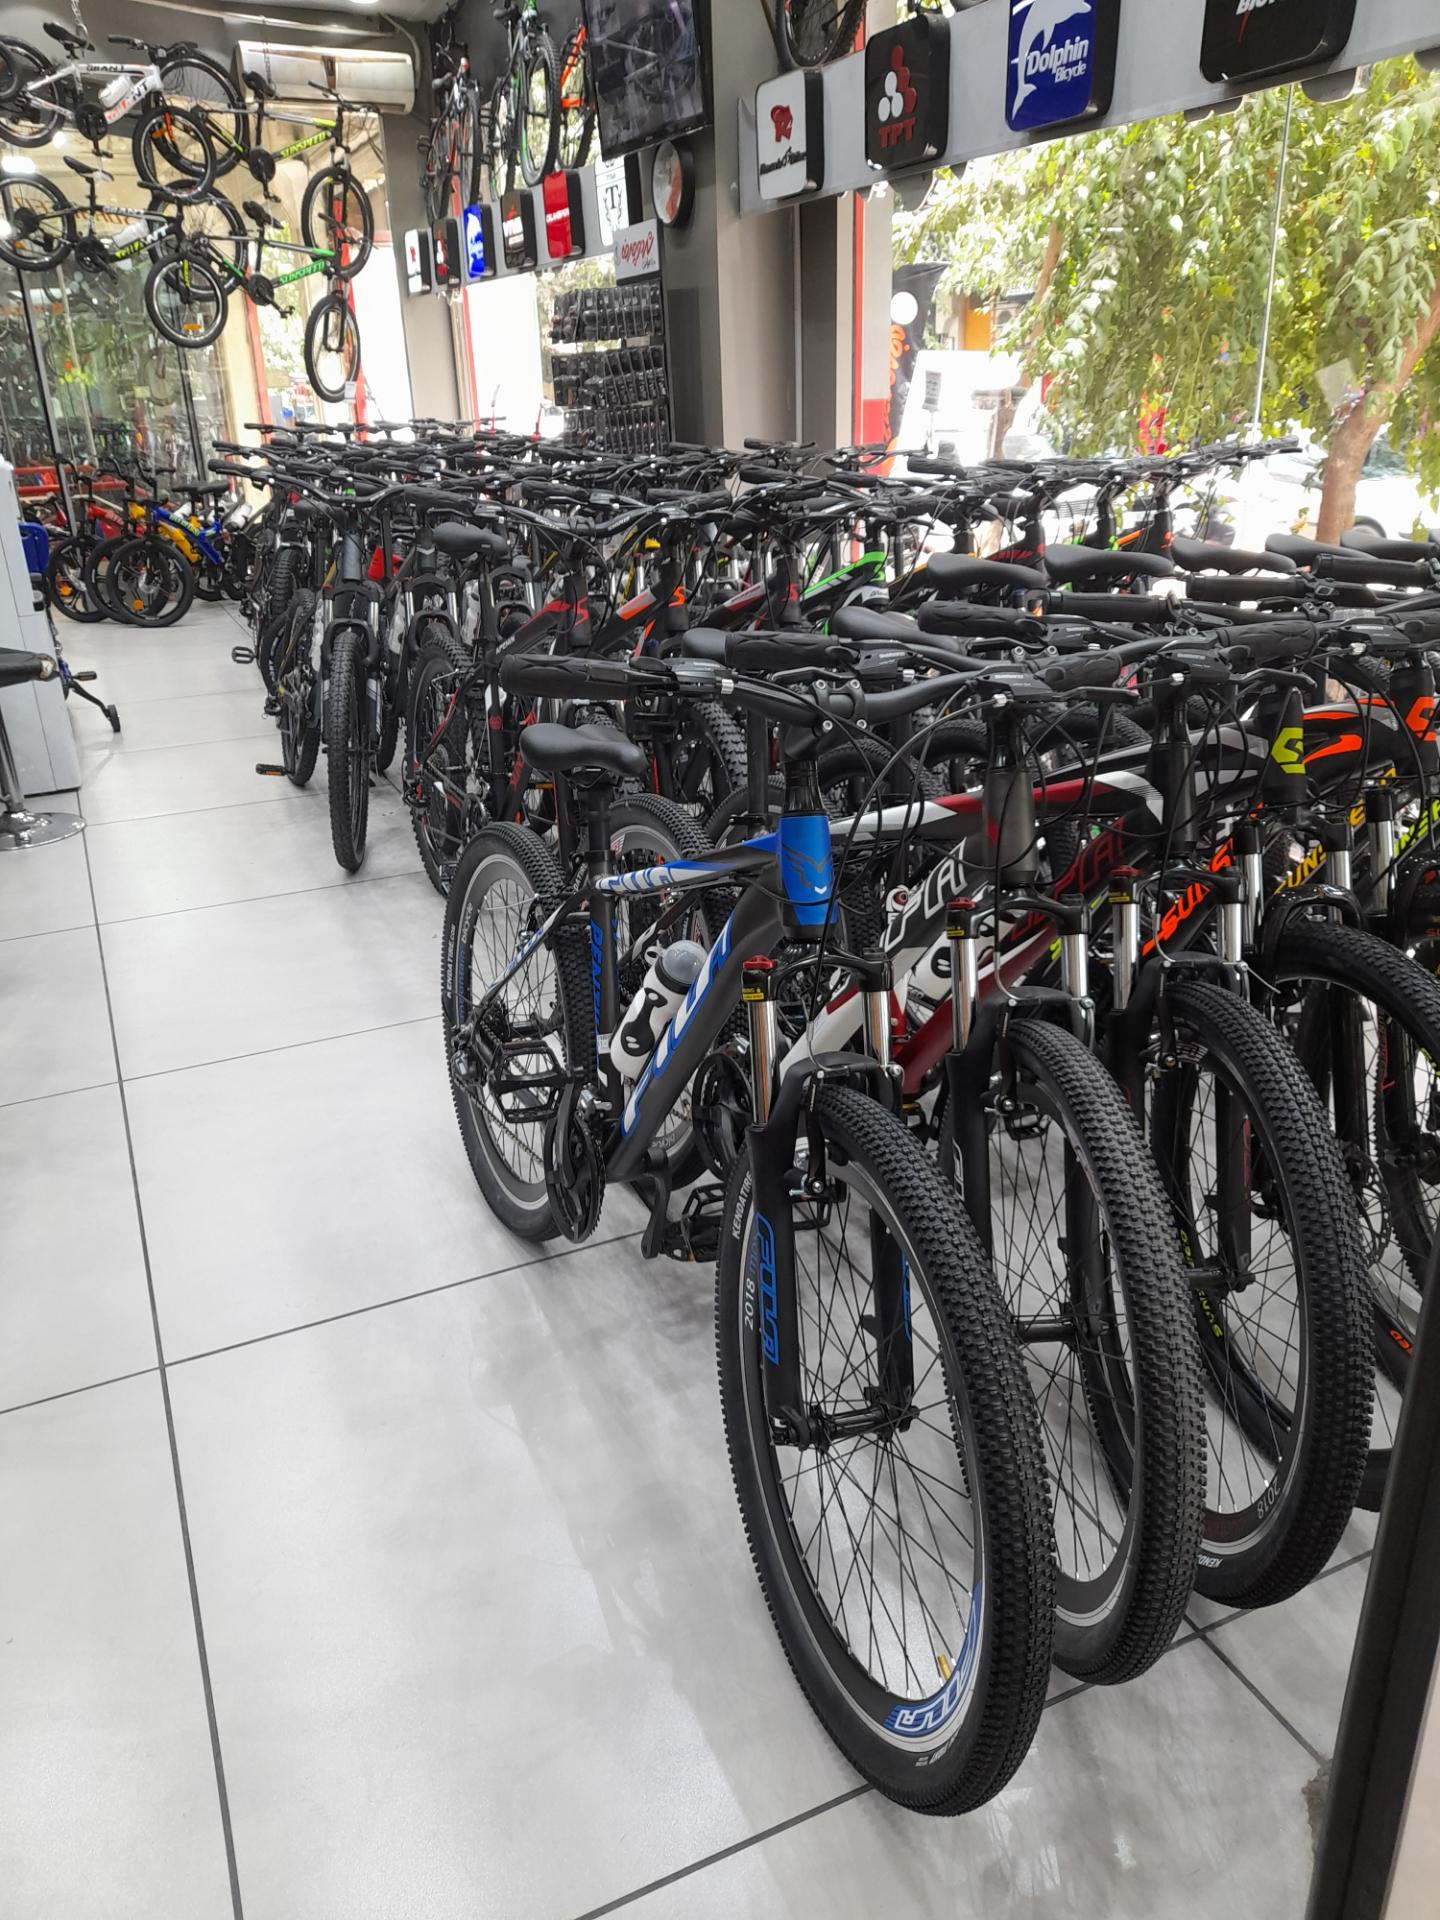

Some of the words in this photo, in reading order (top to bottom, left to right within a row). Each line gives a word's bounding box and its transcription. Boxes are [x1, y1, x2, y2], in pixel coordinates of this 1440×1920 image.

[1026, 36, 1090, 76] Dolphin
[1054, 63, 1087, 83] Bicycle
[744, 1276, 757, 1331] 2018
[1256, 1475, 1281, 1520] 2018
